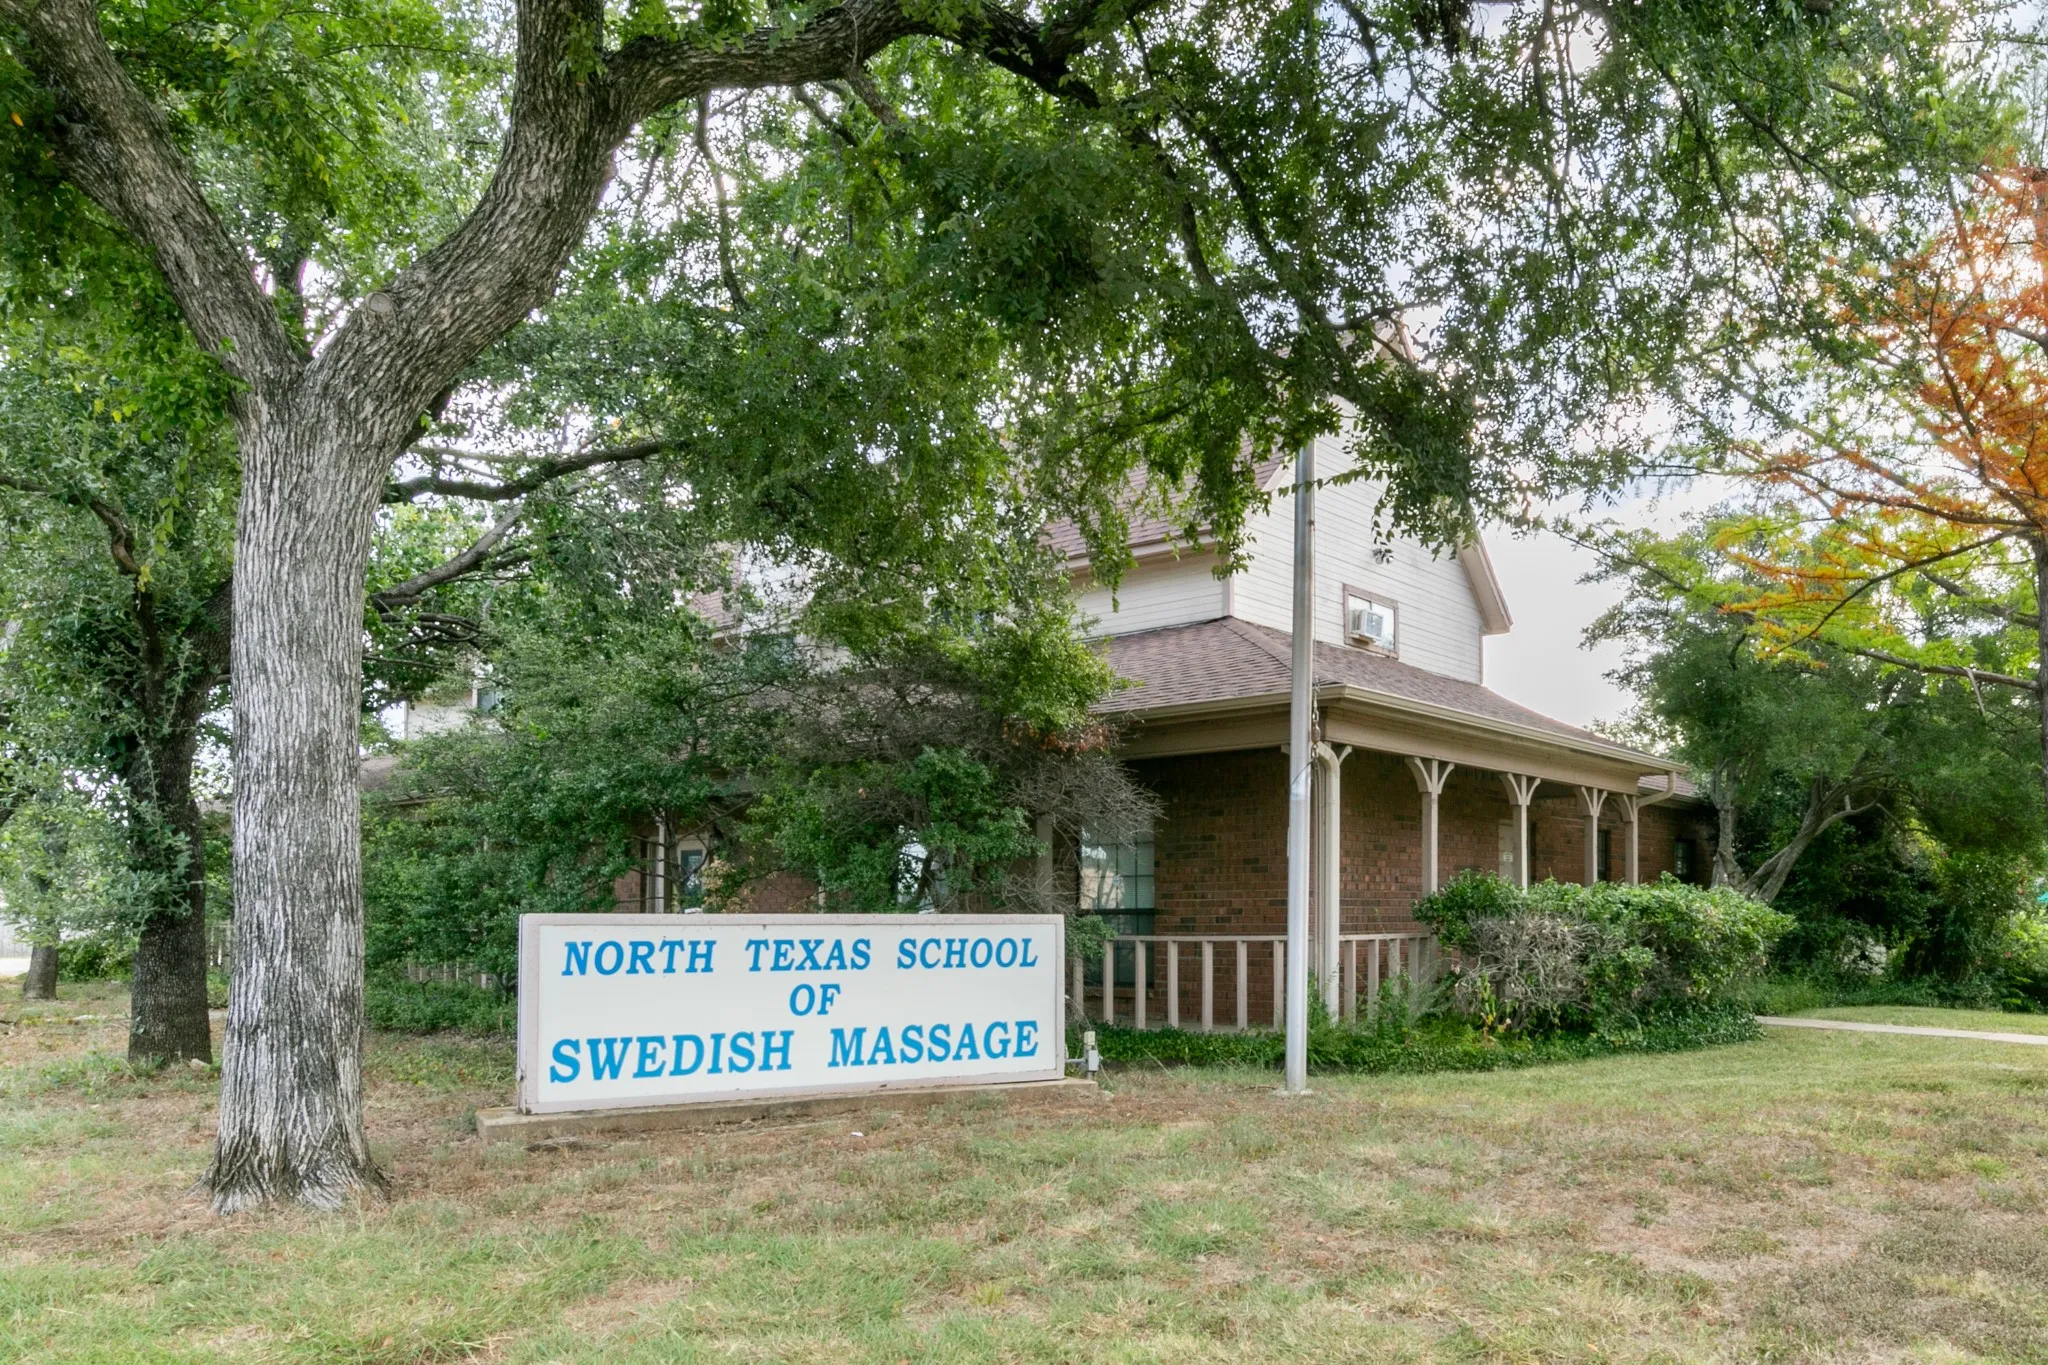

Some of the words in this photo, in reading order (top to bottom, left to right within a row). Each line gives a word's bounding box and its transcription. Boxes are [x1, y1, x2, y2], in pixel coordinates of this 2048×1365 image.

[560, 938, 717, 976] NORTH
[745, 938, 872, 973] TEXAS
[896, 937, 1039, 970] SCHOOL
[788, 983, 842, 1017] OF
[548, 1030, 796, 1084] SWEDISH
[826, 1020, 1039, 1068] MASSAGE
